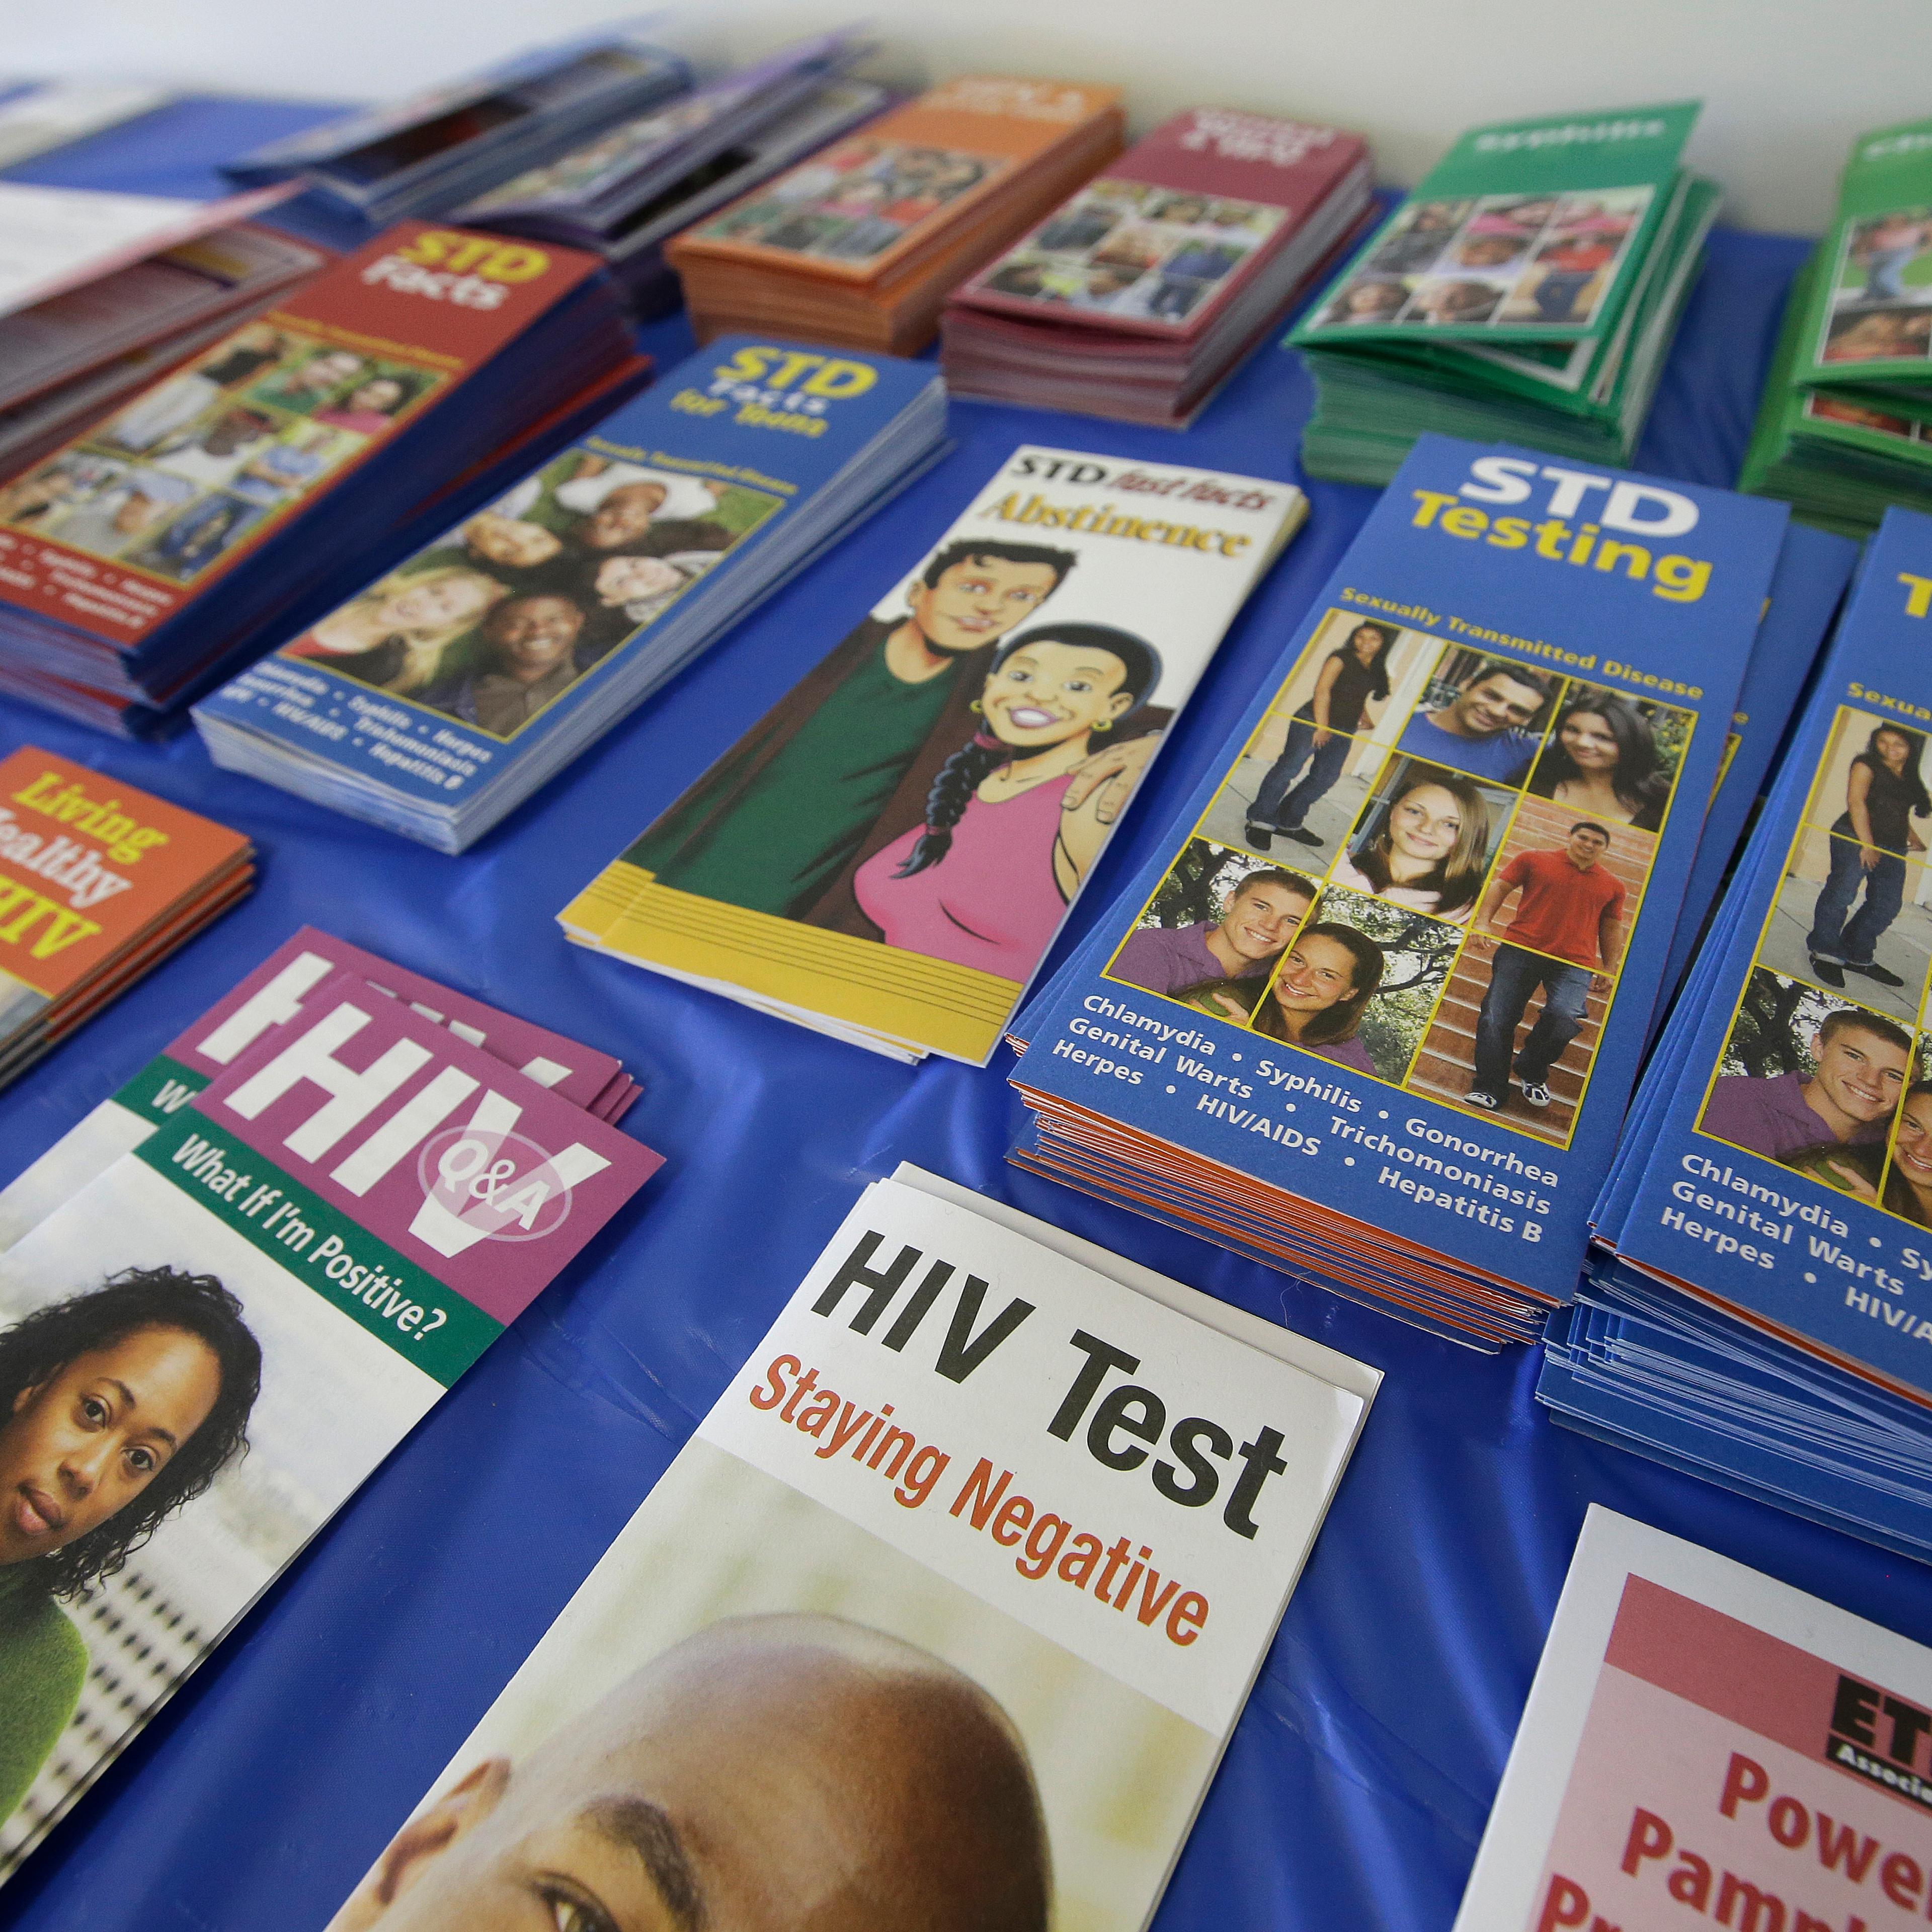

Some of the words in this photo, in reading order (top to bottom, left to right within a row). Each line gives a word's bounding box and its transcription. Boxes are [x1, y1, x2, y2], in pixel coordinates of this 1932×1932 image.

[361, 254, 510, 310] Facts
[401, 230, 551, 283] STD
[713, 346, 878, 399] STD
[1010, 454, 1106, 484] STD
[1459, 456, 1700, 538] STD
[978, 490, 1252, 558] Abstinence
[1412, 489, 1713, 603] Testing
[1340, 586, 1442, 628] Sexually
[1448, 615, 1598, 672] Transmitted
[1602, 659, 1705, 700] Disease
[1847, 682, 1932, 722] Sexua
[0, 809, 134, 909] ealthy
[12, 770, 171, 865] Living
[222, 1000, 613, 1259] HIV
[1052, 1039, 1144, 1085] Herpes
[1195, 1094, 1322, 1157] HIV/AIDS
[1378, 1167, 1514, 1233] Hepatitis
[1522, 1221, 1544, 1243] B
[1068, 1017, 1167, 1065] Genital
[1175, 1054, 1253, 1099] Warts
[1330, 1115, 1552, 1215] Trichomoniasis
[1082, 995, 1217, 1057] Chlamydia
[1255, 1059, 1363, 1113] Syphilis
[1404, 1118, 1559, 1188] Gonorrhea
[437, 1139, 551, 1231] Q&A
[1681, 1154, 1849, 1238] Chlamydia
[172, 1133, 250, 1203] What
[238, 1183, 277, 1219] If
[267, 1203, 315, 1255] I'm
[308, 1235, 449, 1341] Positive?
[1661, 1206, 1775, 1270] Herpes
[1671, 1181, 1794, 1244] Genital
[1808, 1235, 1905, 1296] Warts
[811, 1230, 1036, 1385] HIV
[1046, 1329, 1289, 1540] Test
[748, 1353, 953, 1509] Staying
[949, 1458, 1211, 1648] Negative
[1718, 1750, 1932, 1914] Powe
